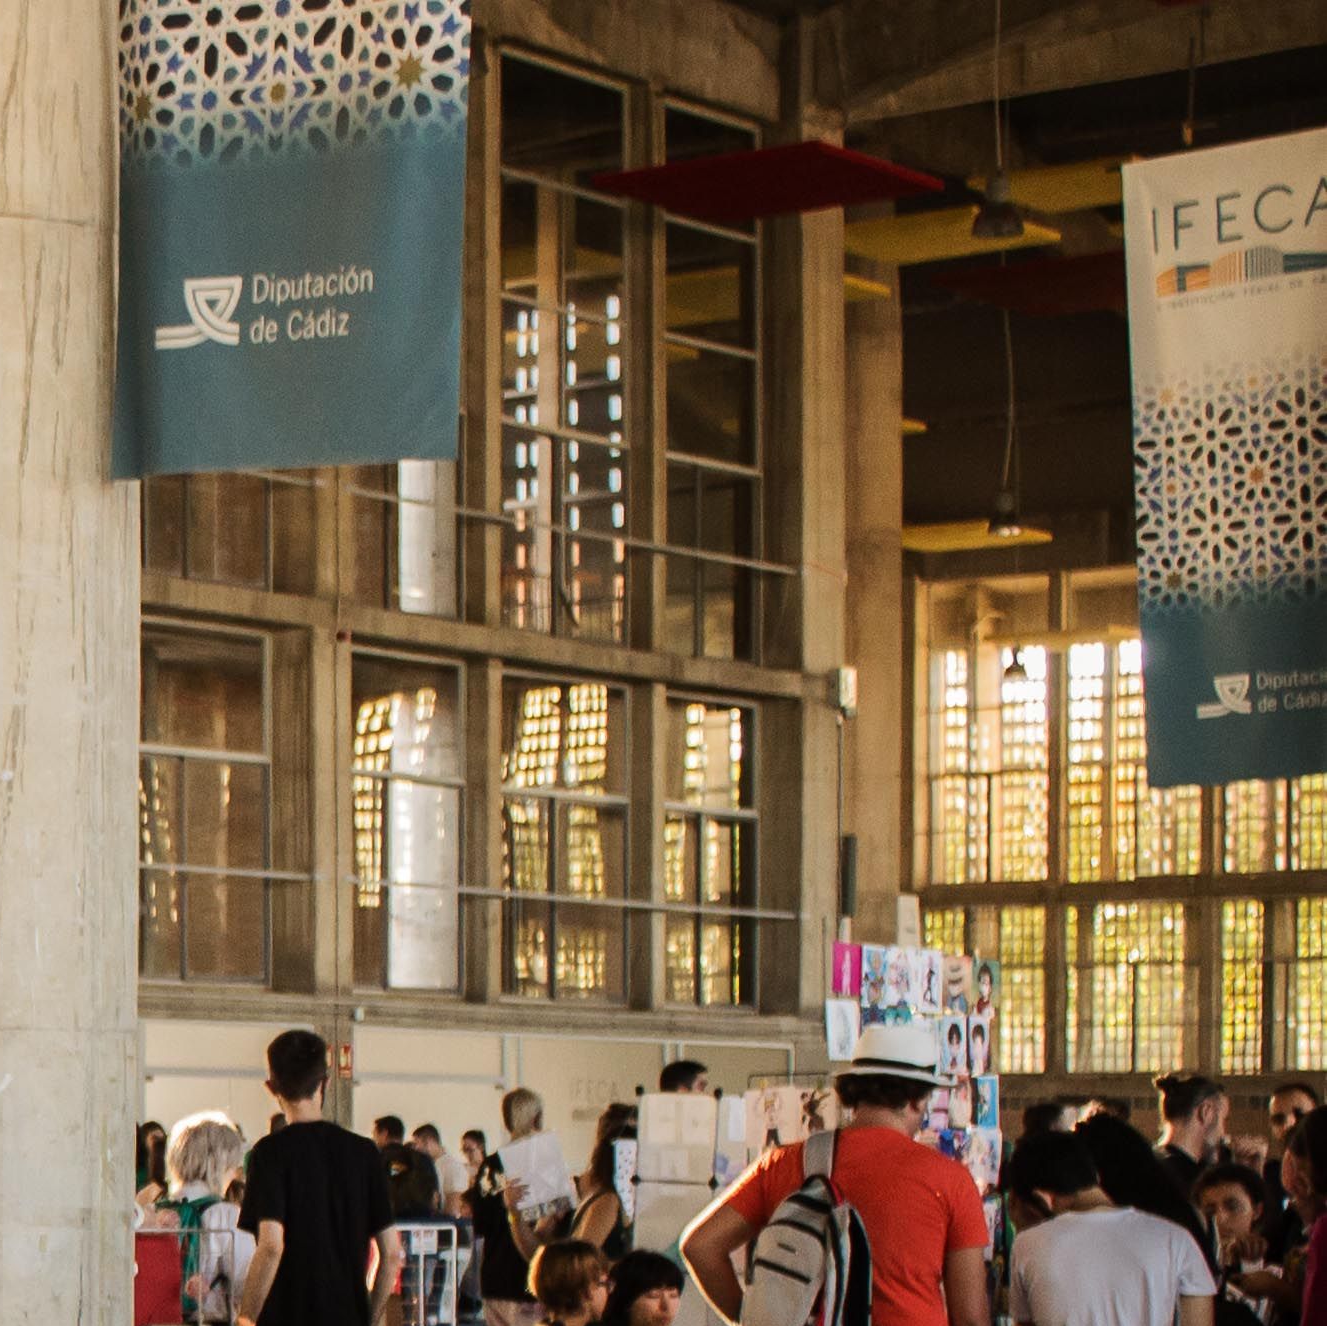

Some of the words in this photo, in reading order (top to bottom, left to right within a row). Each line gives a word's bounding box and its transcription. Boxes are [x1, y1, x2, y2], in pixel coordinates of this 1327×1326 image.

[1151, 175, 1327, 256] IFECA
[252, 266, 374, 306] Diputación
[250, 315, 278, 344] de
[287, 308, 351, 341] Cádiz
[1258, 695, 1277, 713] de
